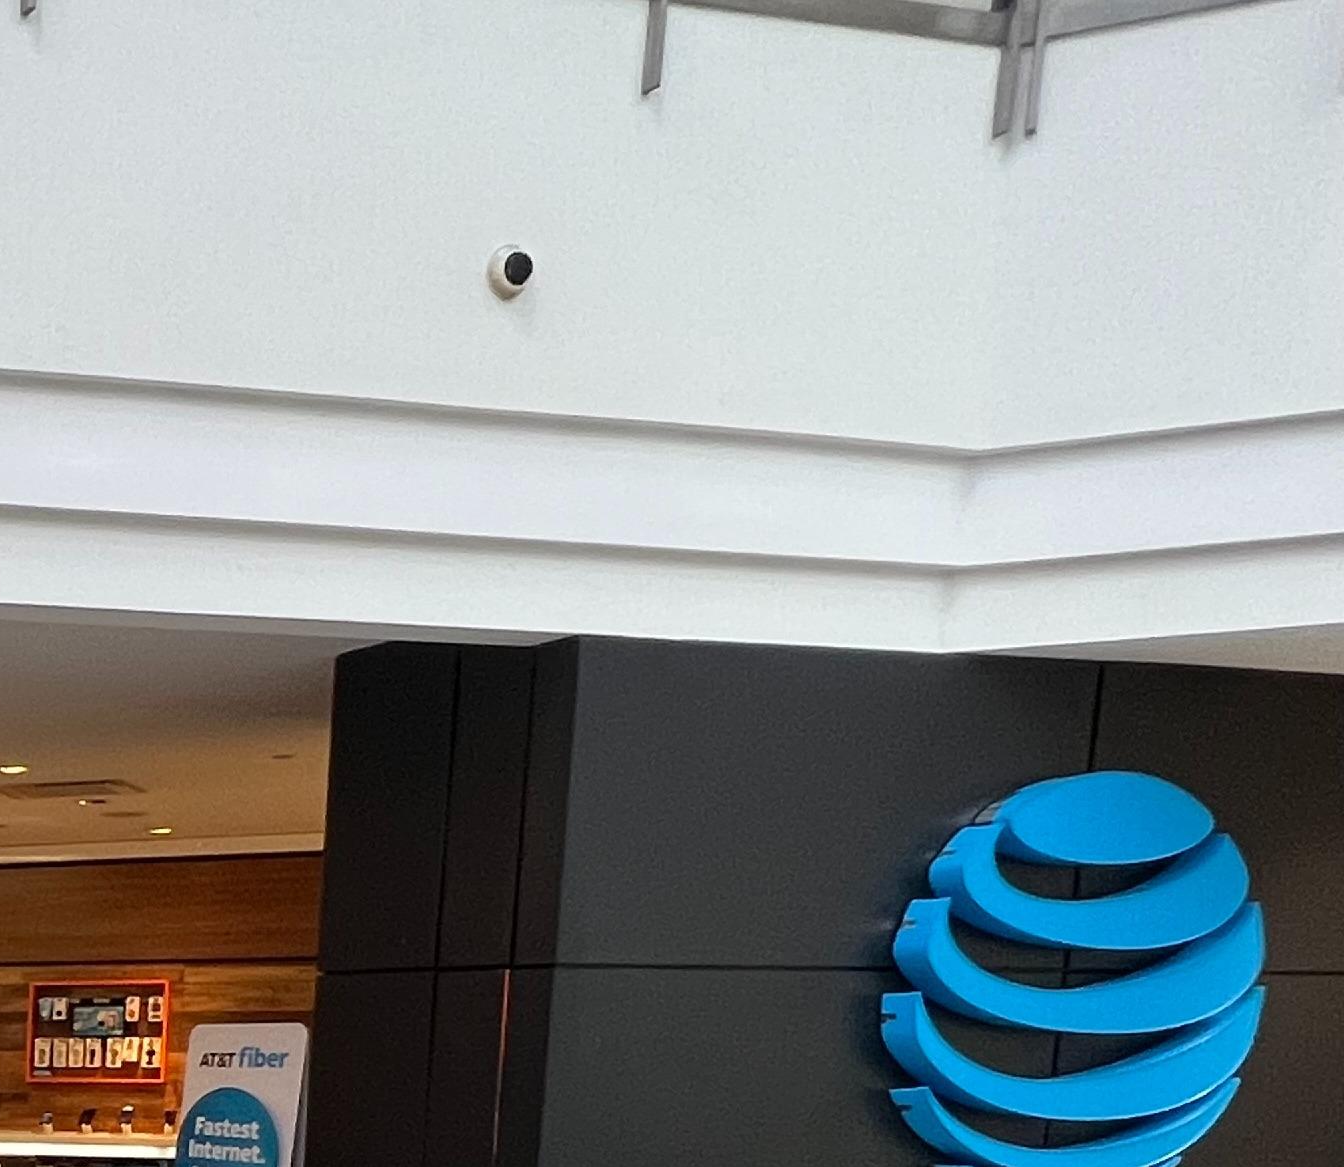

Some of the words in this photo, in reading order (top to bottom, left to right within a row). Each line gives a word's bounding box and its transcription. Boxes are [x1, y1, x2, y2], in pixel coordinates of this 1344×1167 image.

[199, 1052, 236, 1068] AT&T
[238, 1046, 289, 1068] fiber
[194, 1116, 260, 1140] Fastest
[188, 1139, 266, 1164] Internet.
